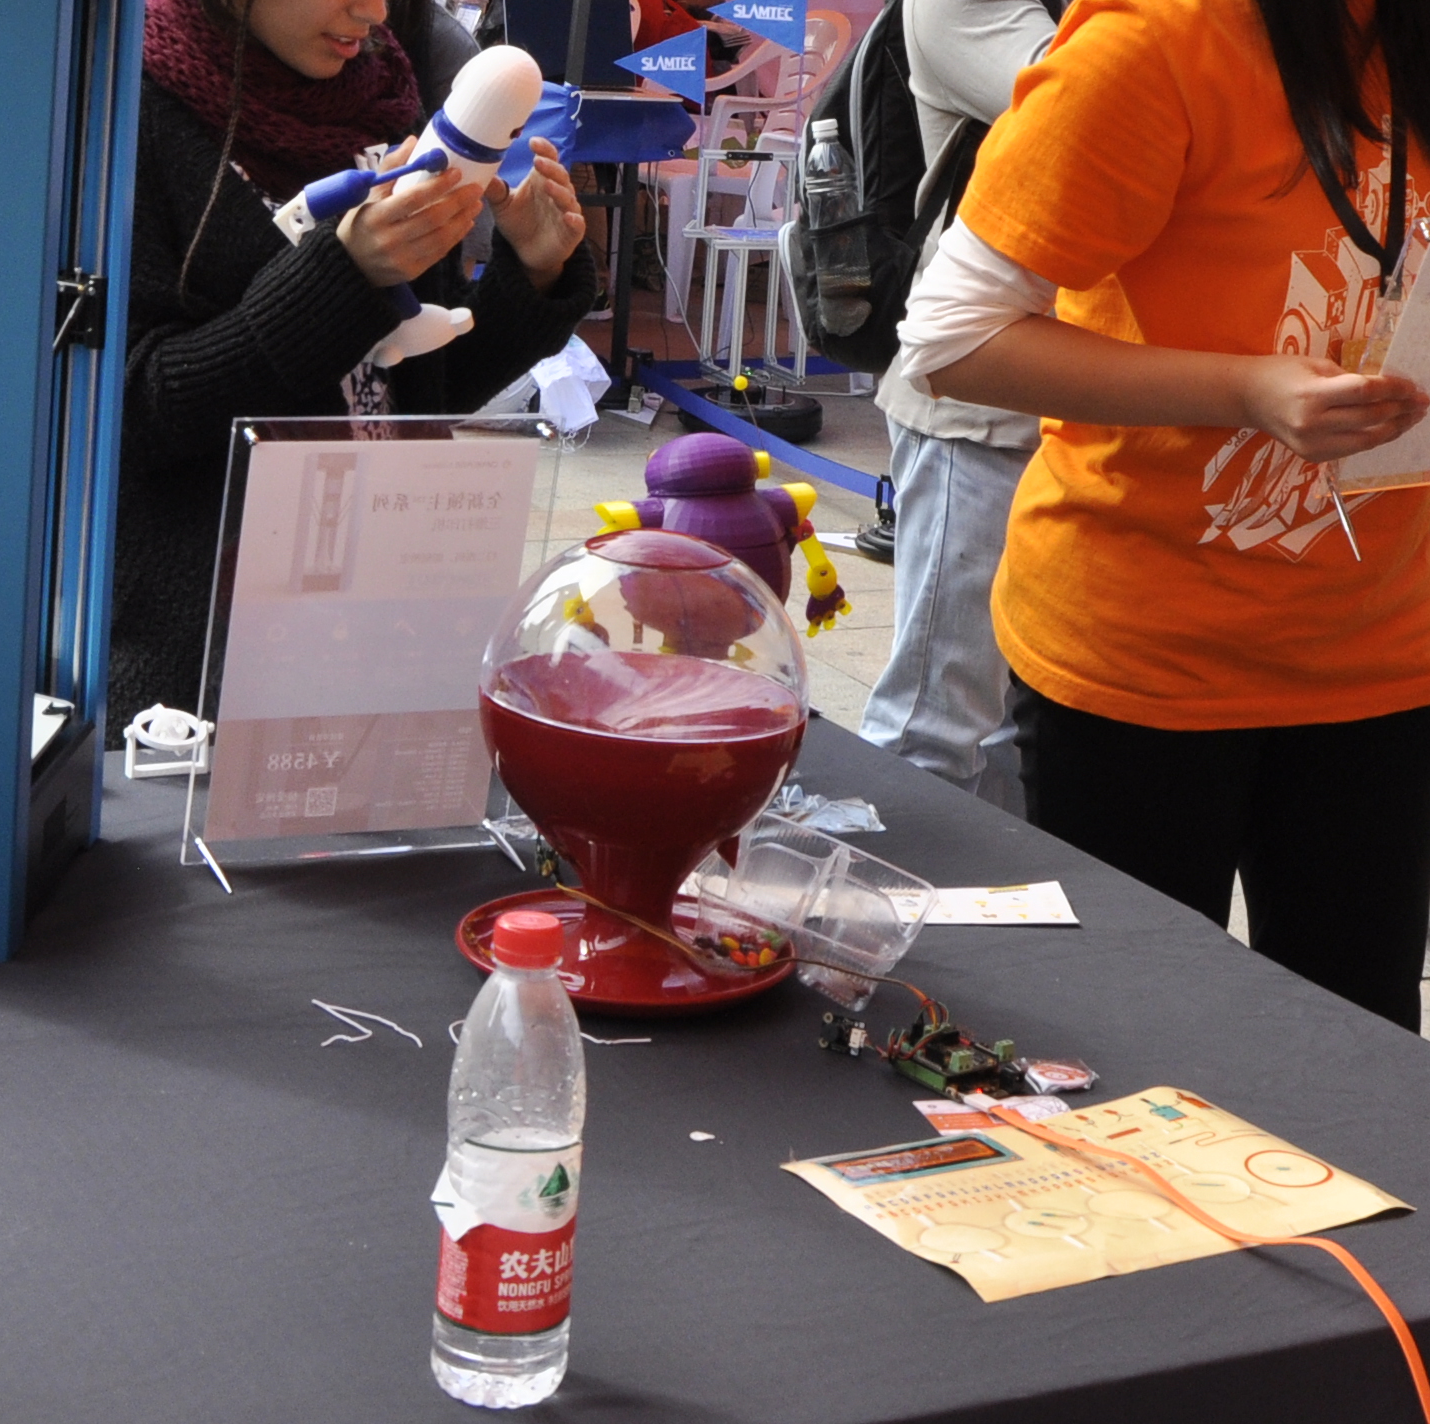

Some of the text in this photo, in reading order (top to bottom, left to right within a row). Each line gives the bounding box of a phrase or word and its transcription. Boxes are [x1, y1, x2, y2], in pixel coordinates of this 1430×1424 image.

[733, 3, 794, 21] SLAMTEC
[640, 55, 697, 71] SLAMTEC
[497, 1279, 552, 1297] NONGFU
